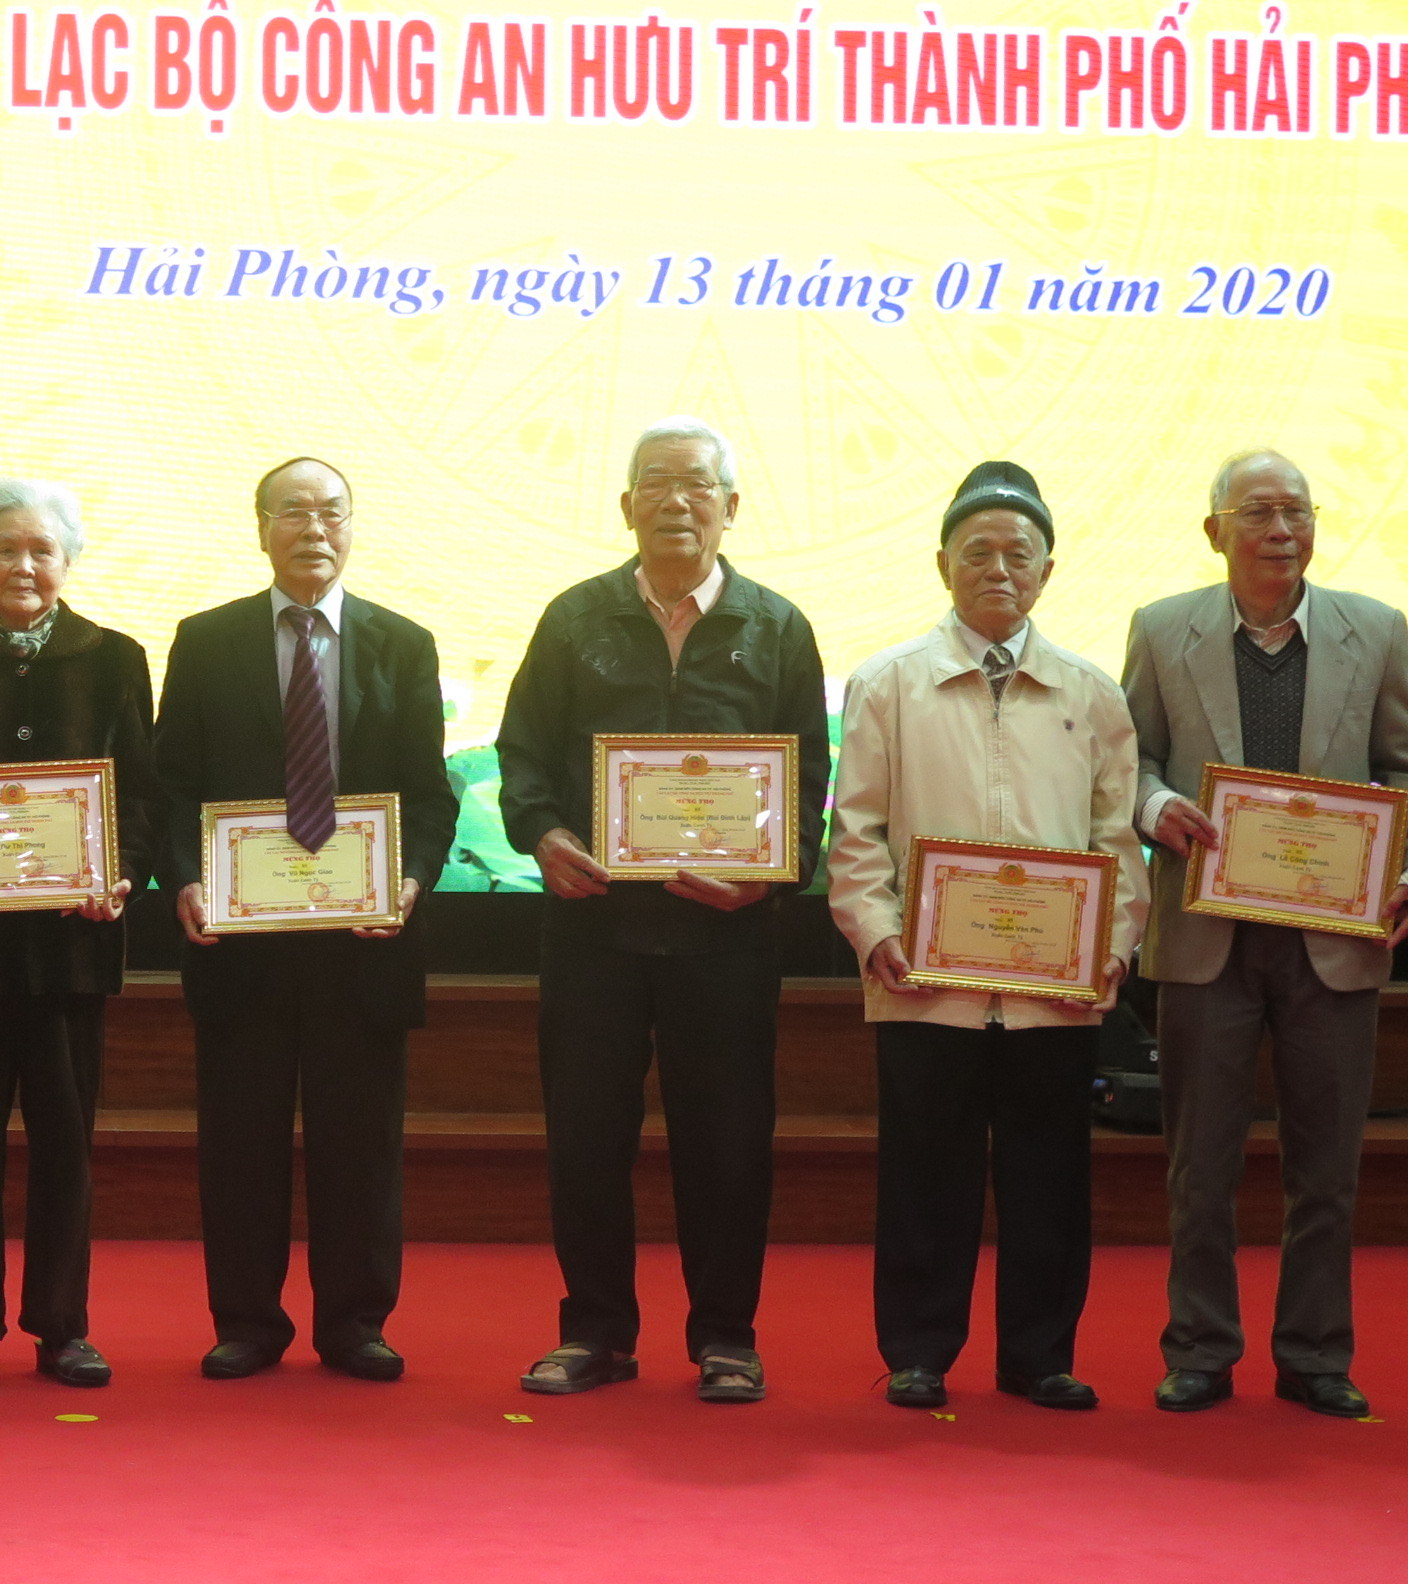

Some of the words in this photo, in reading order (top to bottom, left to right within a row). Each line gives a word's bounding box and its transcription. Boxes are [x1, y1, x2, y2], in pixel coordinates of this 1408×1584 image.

[12, 13, 129, 131] LẠC
[155, 0, 236, 133] BỘ
[262, 0, 435, 115] CÔNG
[458, 22, 546, 117] AN
[571, 16, 693, 120] HƯU
[716, 8, 813, 122] TRÍ
[834, 11, 1041, 127] THÀNH
[1065, 2, 1190, 131] PHỐ
[1211, 5, 1311, 133] HẢI
[85, 247, 205, 297] Hải
[226, 249, 445, 315] Phòng,
[470, 253, 620, 317] ngày
[646, 256, 713, 305] 13
[734, 258, 914, 324] tháng
[935, 261, 1004, 310] 01
[1027, 266, 1160, 313] năm
[1182, 265, 1330, 317] 2020
